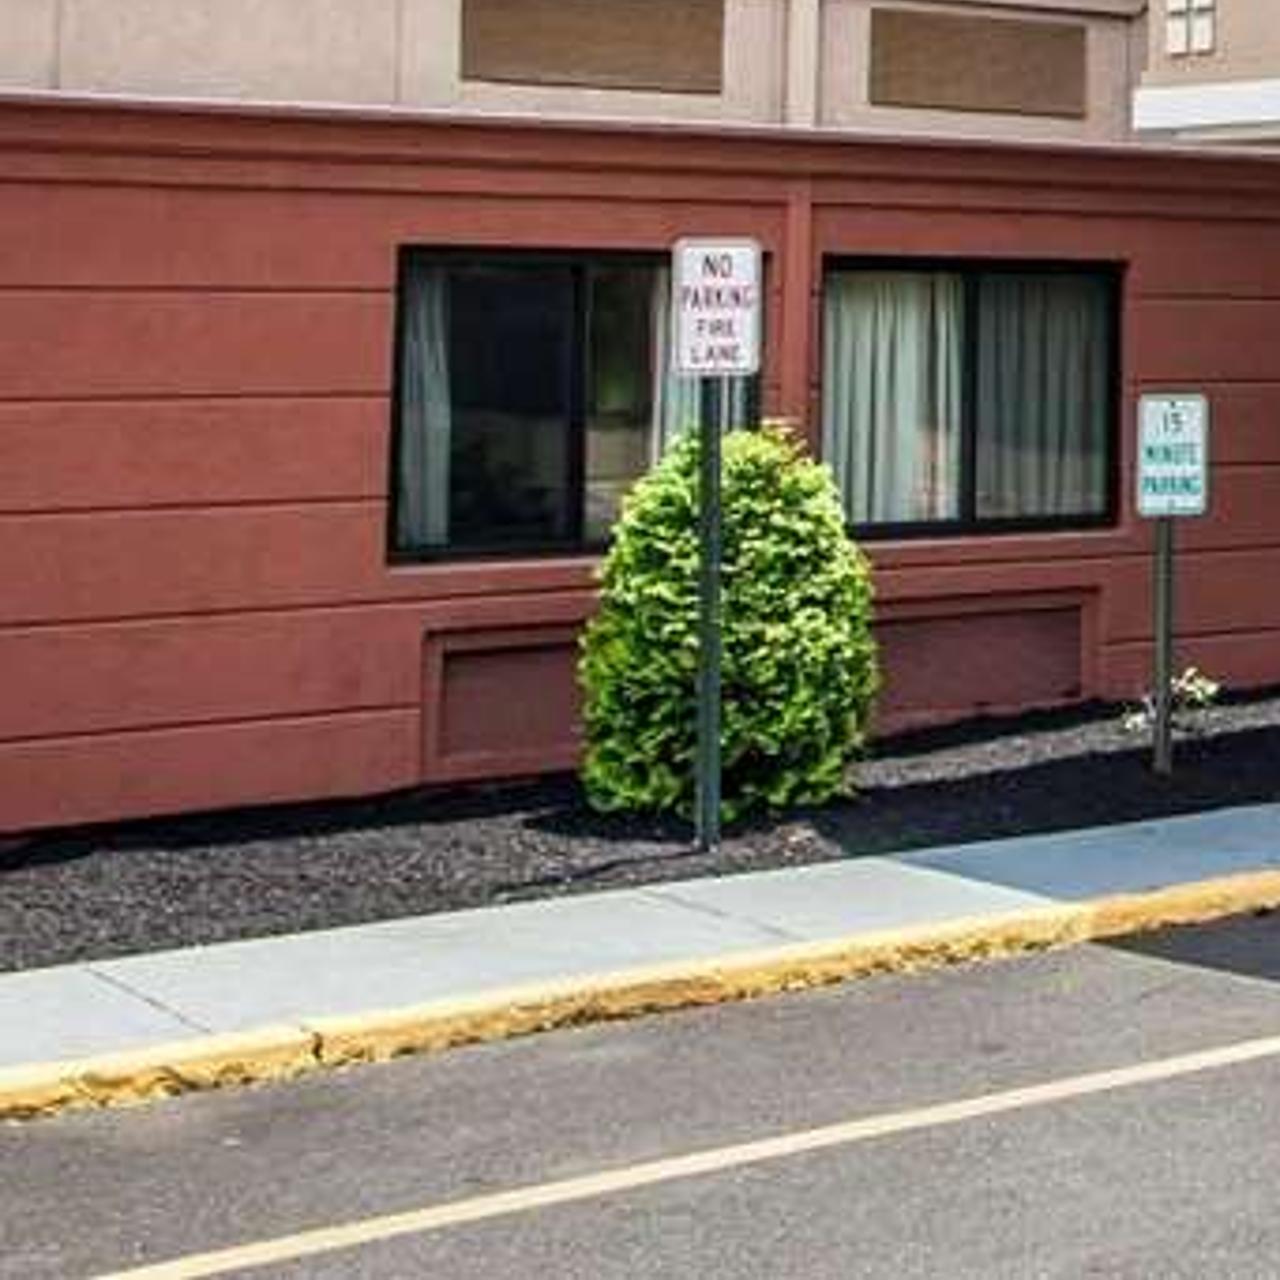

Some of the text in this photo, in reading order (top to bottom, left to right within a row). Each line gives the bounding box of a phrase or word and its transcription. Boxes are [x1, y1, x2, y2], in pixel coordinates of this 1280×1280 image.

[702, 254, 733, 278] NO
[682, 286, 754, 310] PARKING
[697, 319, 733, 338] FIRE
[691, 344, 741, 364] LANE
[1163, 412, 1183, 433] 15
[1144, 443, 1201, 466] MINUTE
[1143, 476, 1201, 496] PARKING
